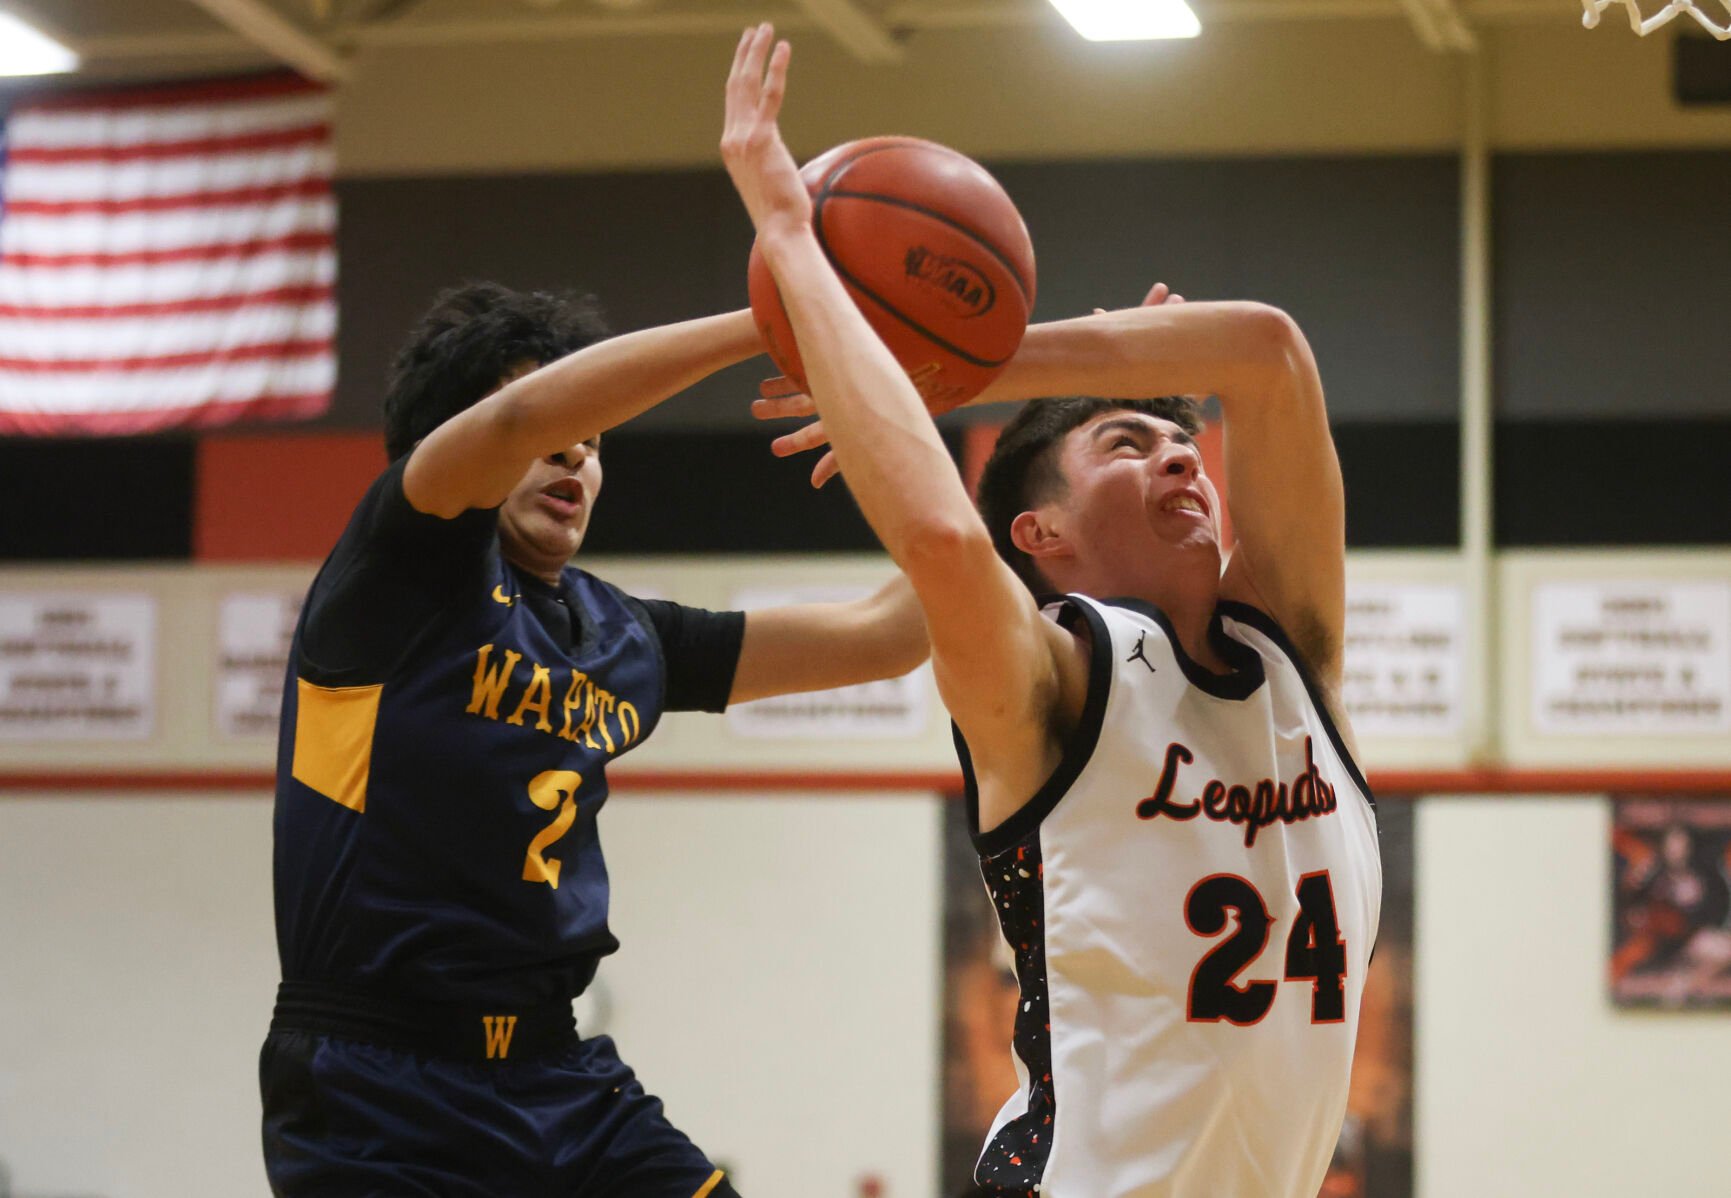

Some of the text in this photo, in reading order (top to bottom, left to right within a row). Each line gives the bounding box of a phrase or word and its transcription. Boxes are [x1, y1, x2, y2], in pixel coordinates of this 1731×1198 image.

[521, 770, 582, 889] 2
[1136, 735, 1337, 848] Leopds
[1183, 869, 1347, 1027] 24
[482, 1015, 518, 1059] W
